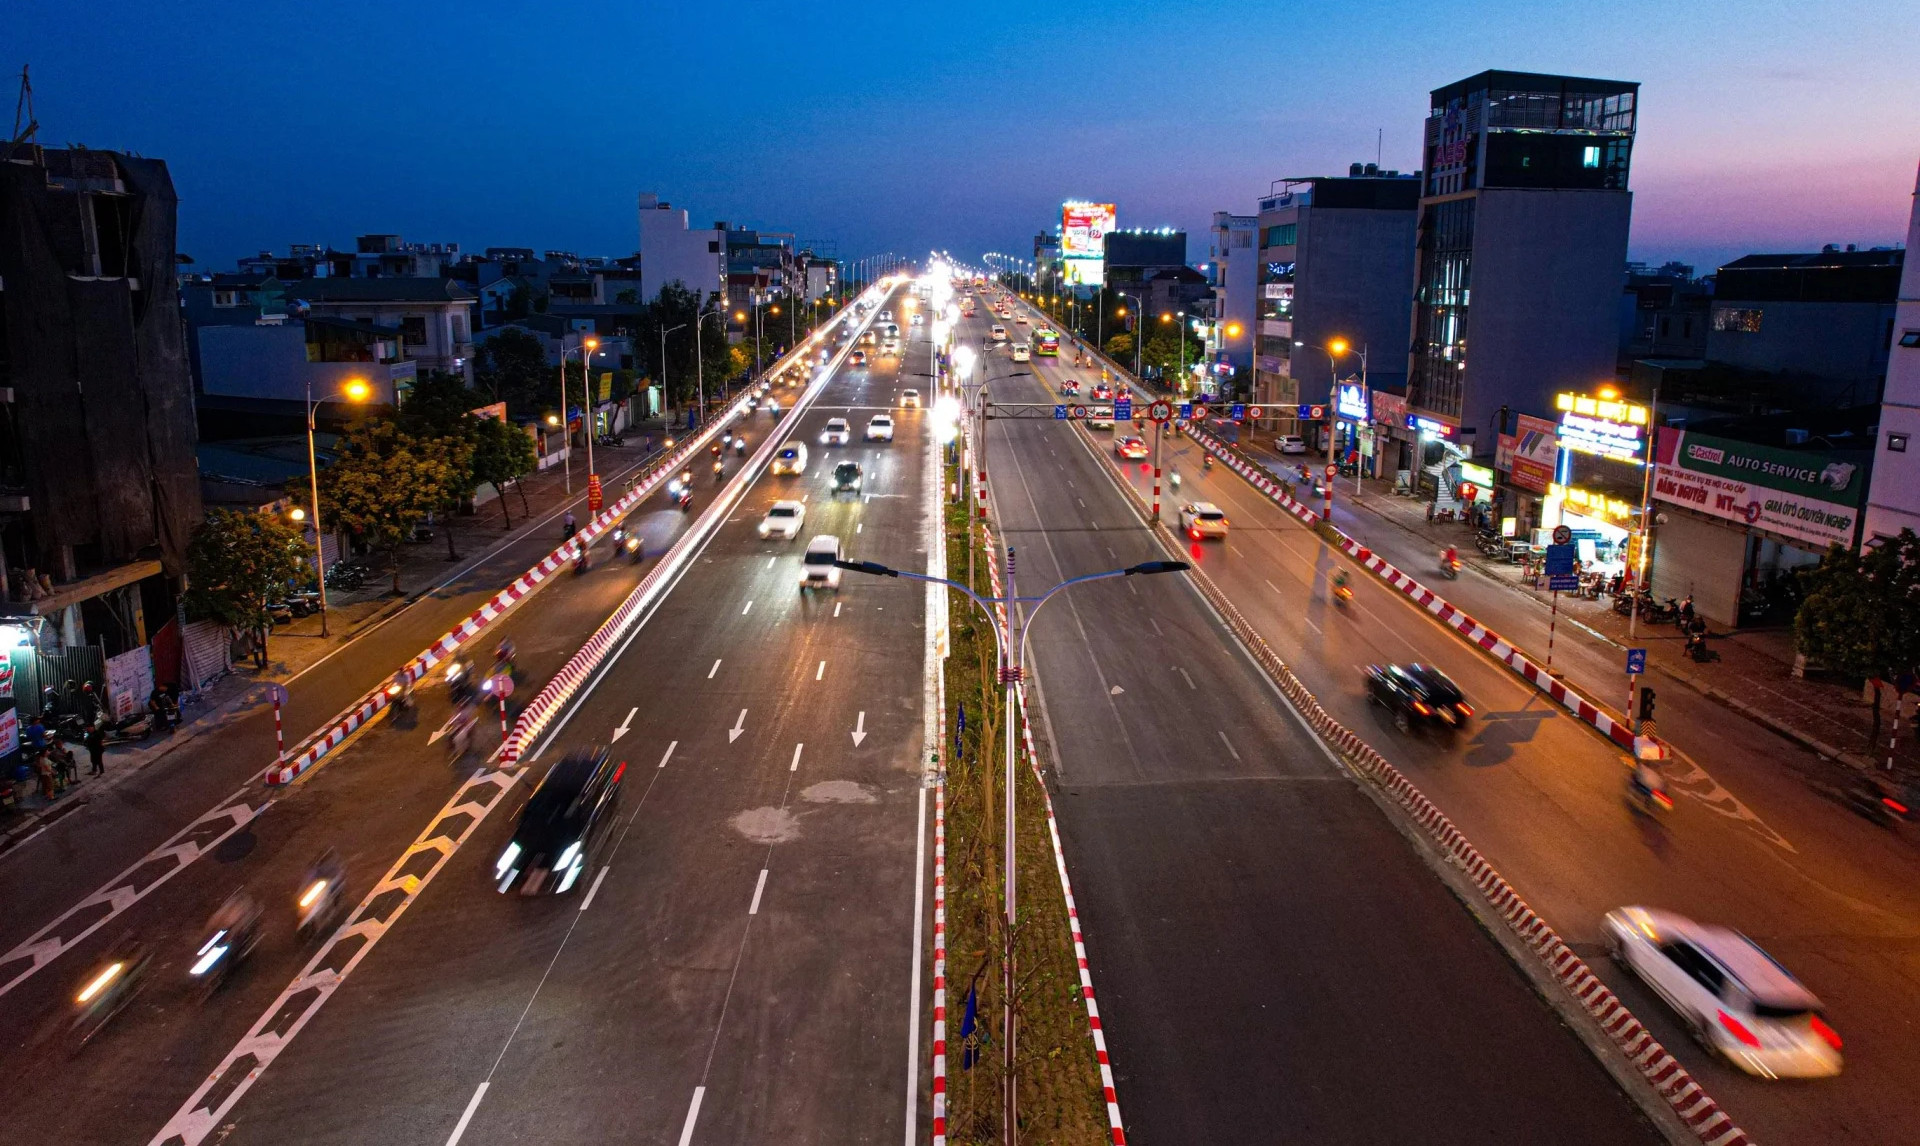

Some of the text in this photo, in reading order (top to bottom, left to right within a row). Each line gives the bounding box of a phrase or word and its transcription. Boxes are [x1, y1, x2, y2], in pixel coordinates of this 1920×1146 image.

[1695, 447, 1724, 463] Castrol
[1727, 454, 1817, 483] AUTO SERVICE
[1722, 482, 1734, 491] CAO
[1765, 500, 1782, 514] GARA
[1797, 507, 1826, 525] CHUYÊN
